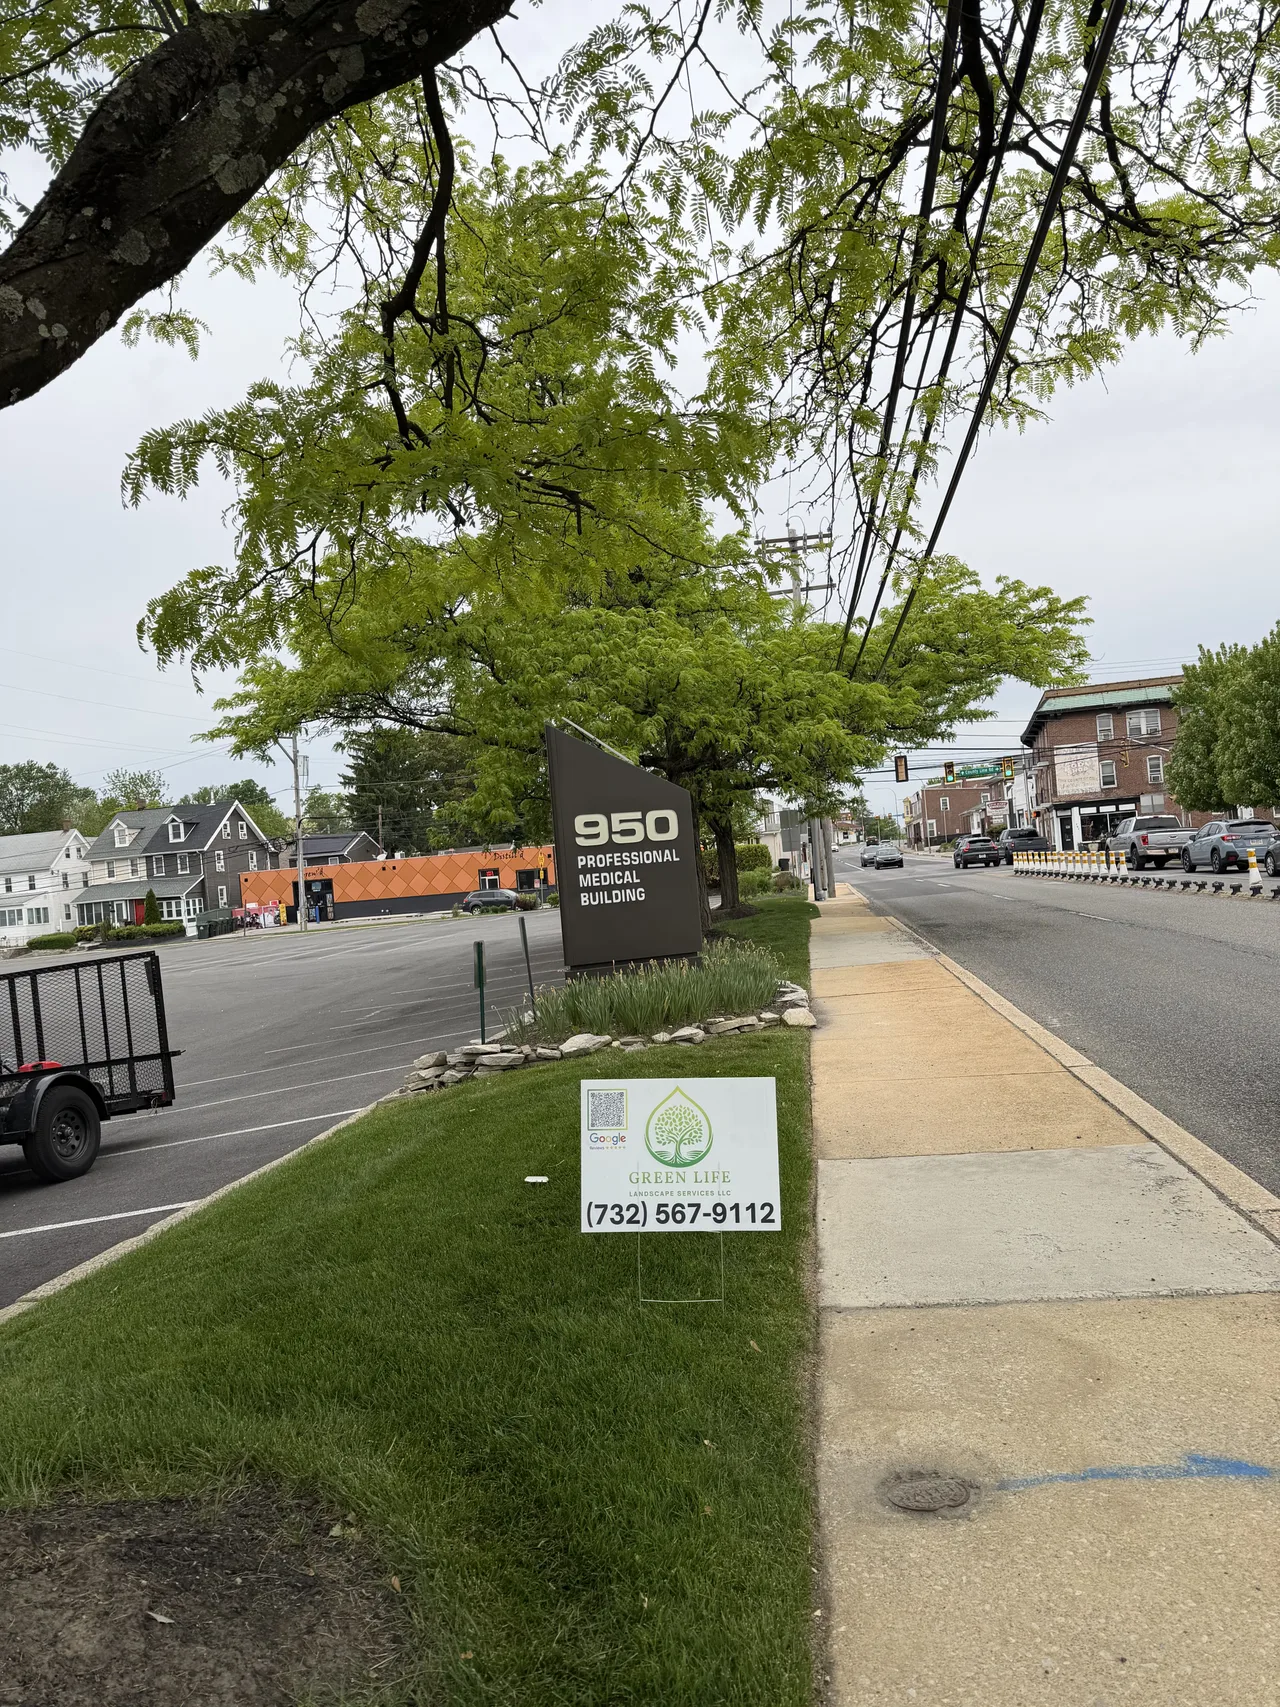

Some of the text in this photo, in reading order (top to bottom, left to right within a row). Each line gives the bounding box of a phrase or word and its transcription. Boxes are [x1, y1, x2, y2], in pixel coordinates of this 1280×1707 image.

[574, 809, 679, 846] 950
[577, 849, 680, 869] PROFESSIONAL
[578, 870, 641, 887] MEDICAL
[580, 888, 646, 906] BUILDING
[589, 1132, 627, 1146] Google
[628, 1170, 731, 1184] GREEN LIFE
[586, 1201, 776, 1228] (732) 567-9112
